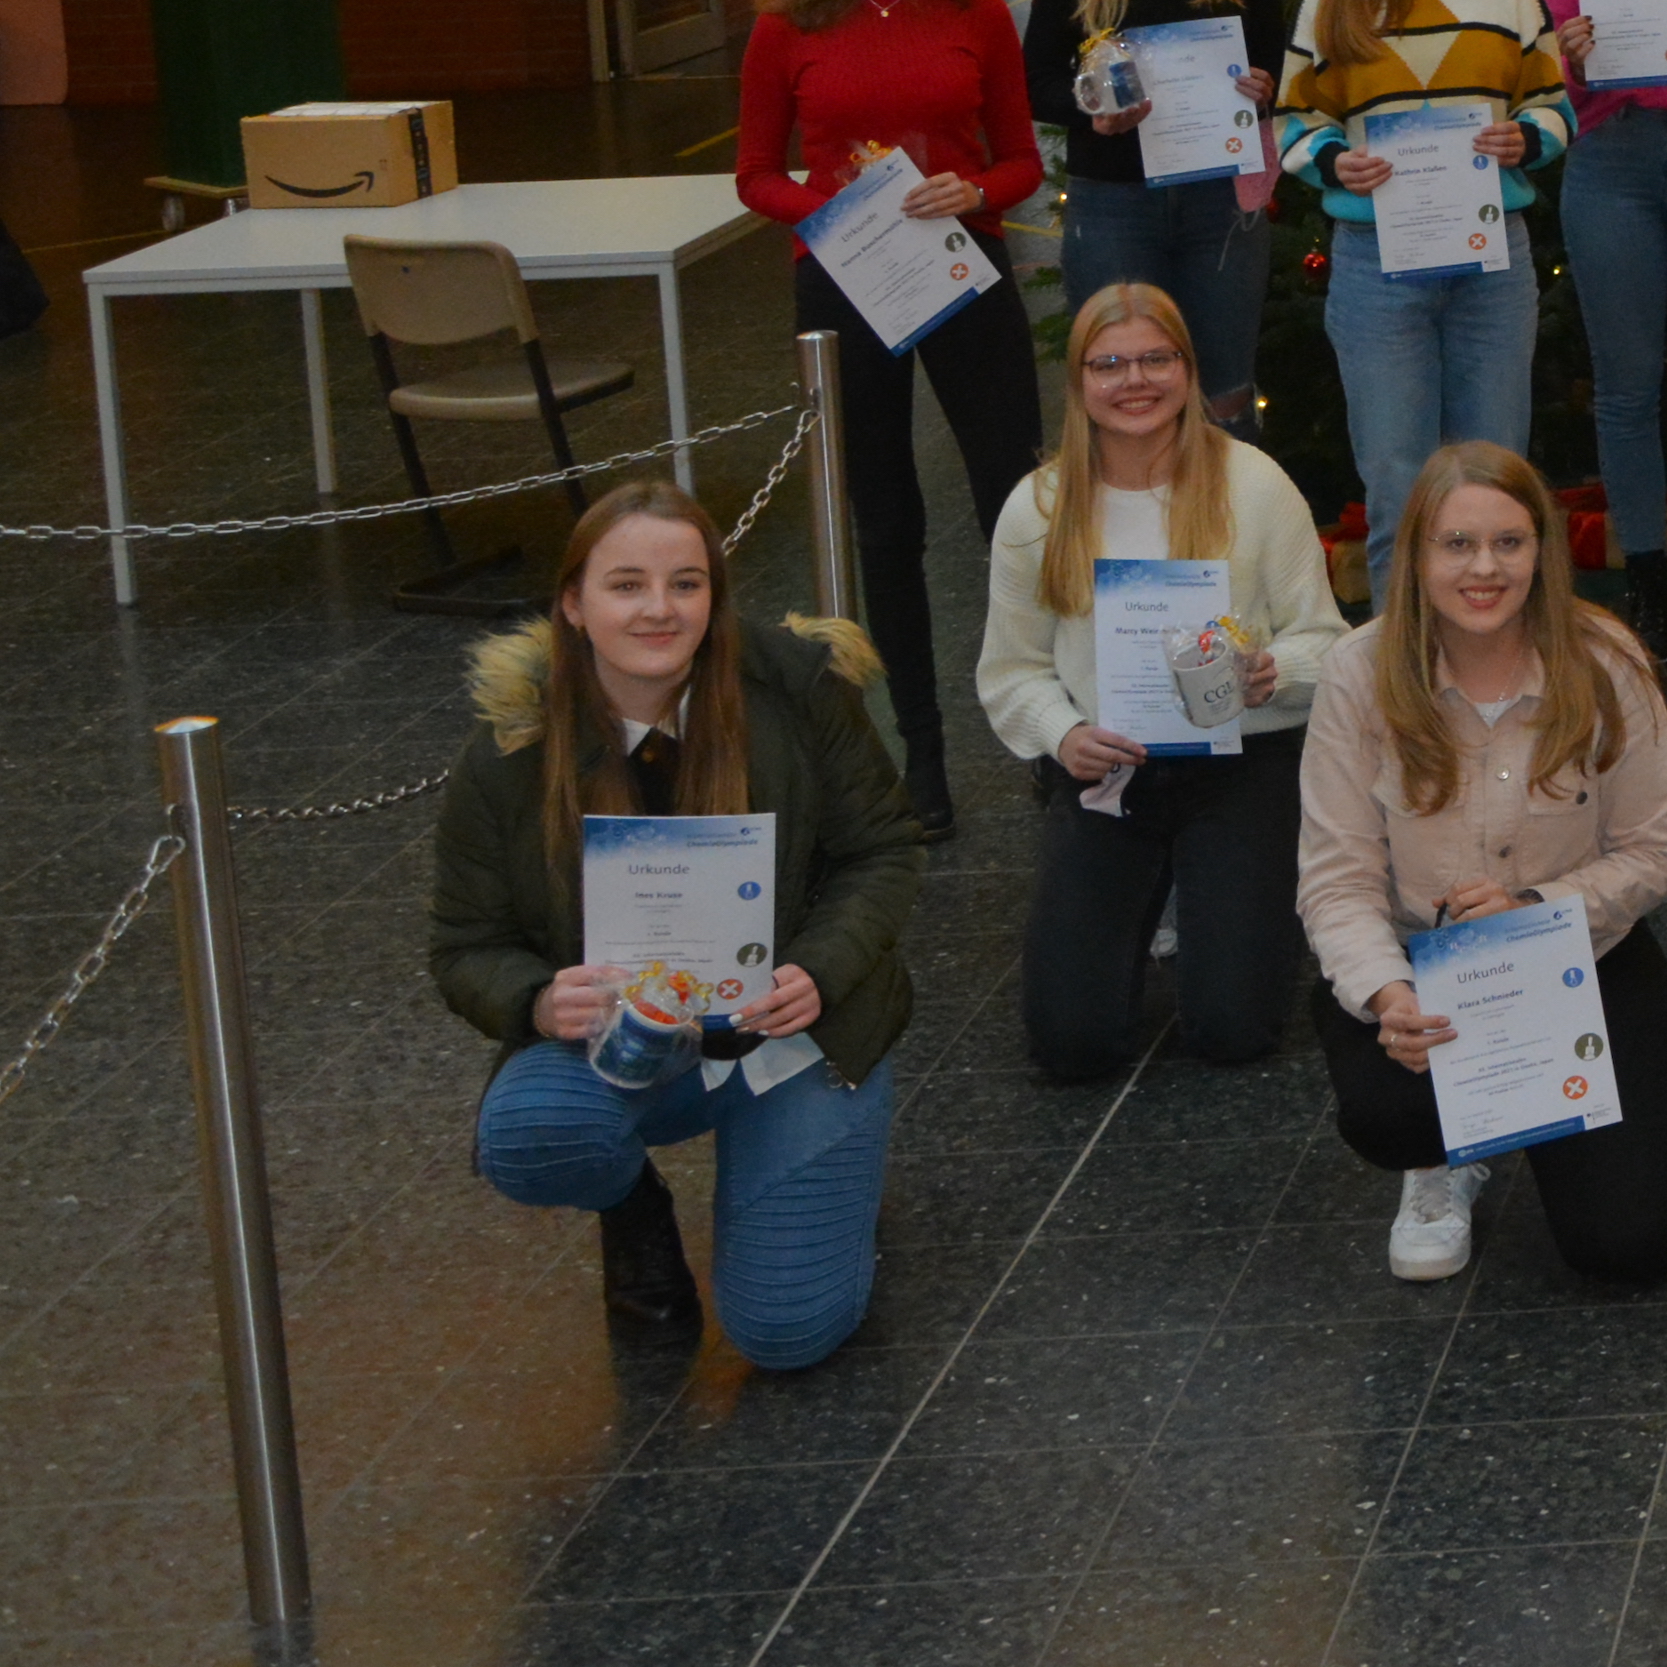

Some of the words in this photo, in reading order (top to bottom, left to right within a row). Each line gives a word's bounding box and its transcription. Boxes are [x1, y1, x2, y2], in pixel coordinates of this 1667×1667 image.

[1397, 144, 1439, 157] Urkunde
[841, 211, 878, 243] Urkunde
[1125, 601, 1169, 613] Urkunde
[628, 864, 690, 875] Urkunde
[1457, 961, 1515, 984] Urkunde
[1458, 998, 1480, 1010] Klara
[1482, 988, 1524, 1004] Schnieder
